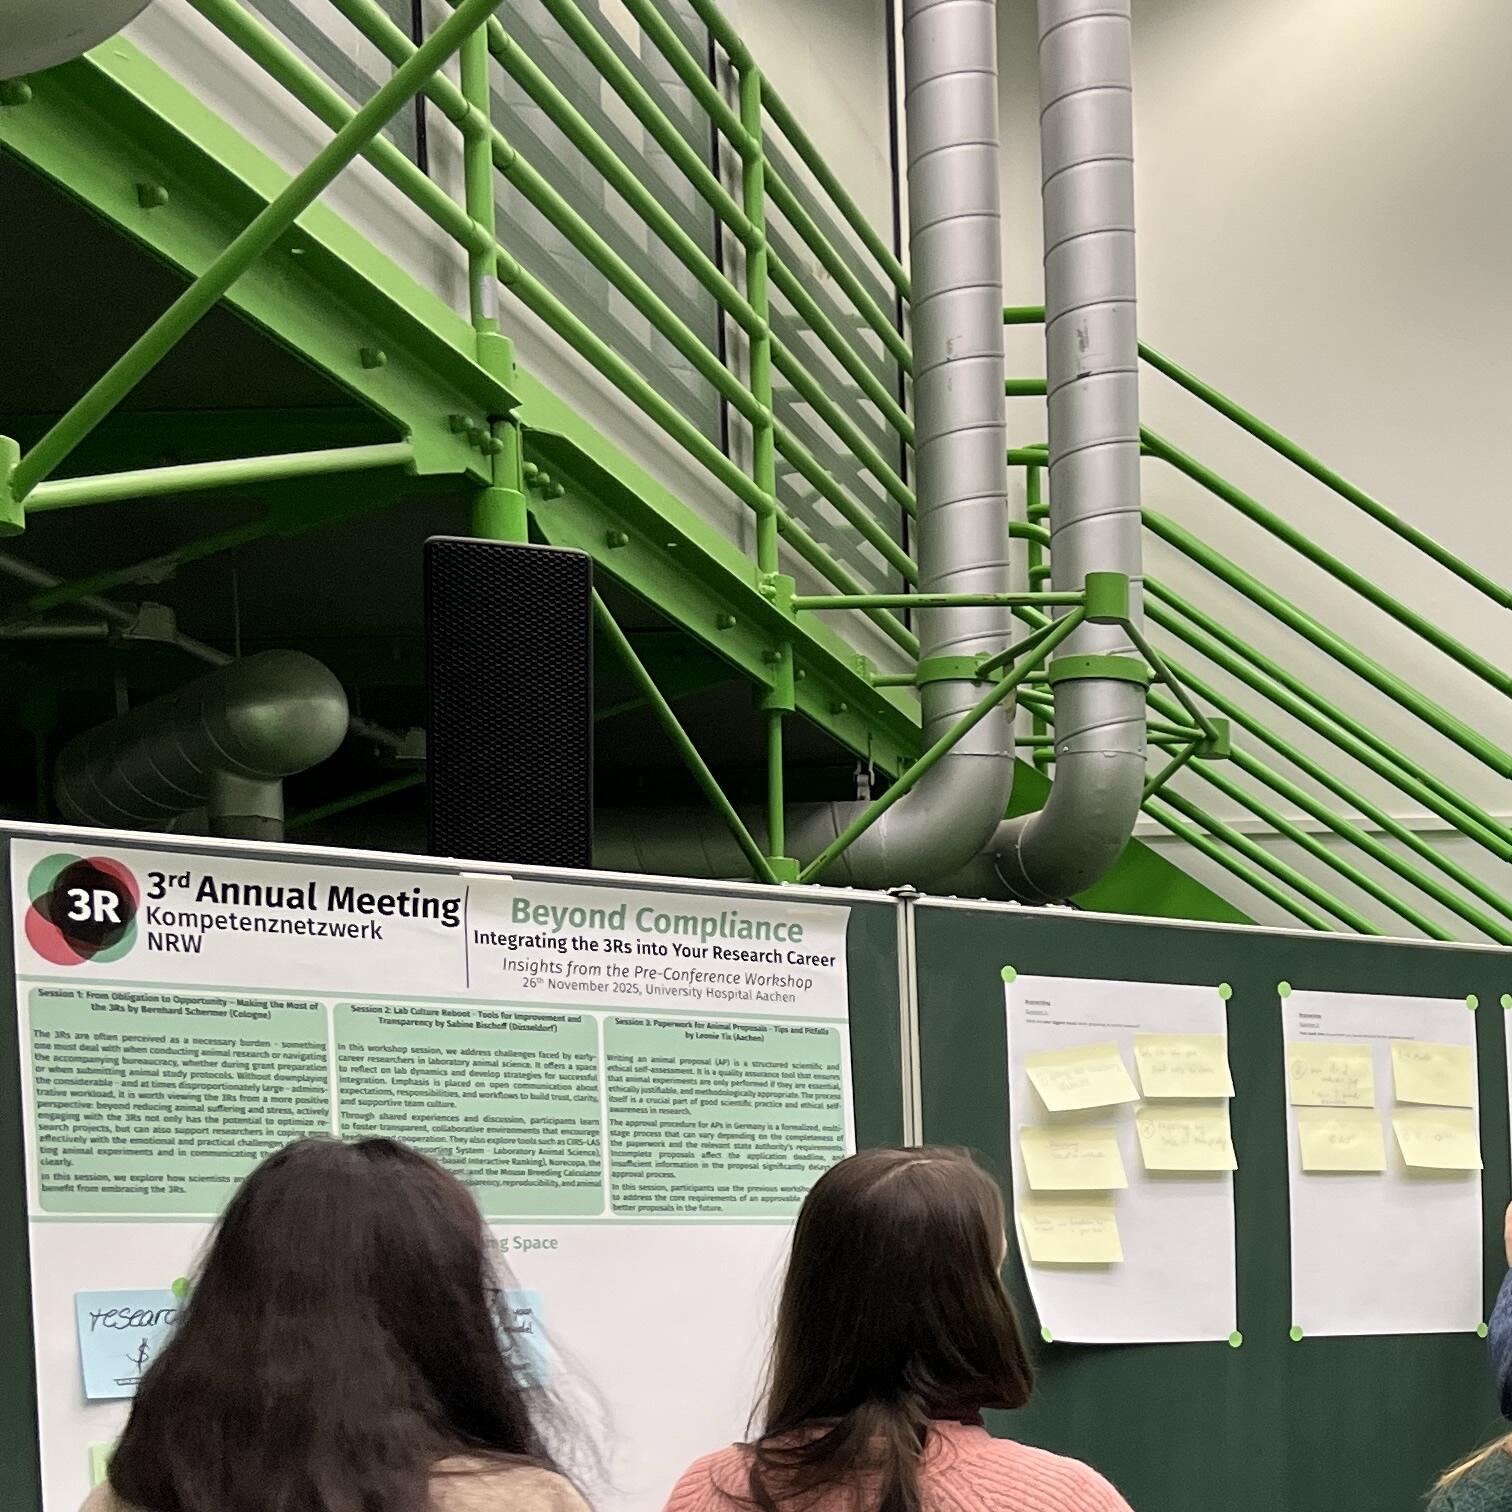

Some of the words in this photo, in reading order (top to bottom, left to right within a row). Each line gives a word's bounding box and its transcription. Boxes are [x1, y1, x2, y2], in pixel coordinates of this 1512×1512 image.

[66, 887, 122, 924] 3R
[147, 870, 190, 899] 3rd
[195, 875, 316, 910] Annual
[327, 885, 460, 927] Meeting
[146, 906, 382, 939] Kompetenznetzwerk
[511, 896, 627, 933] Beyond
[635, 904, 804, 943] Compliance
[147, 931, 201, 953] NRW
[474, 929, 567, 953] Integrating
[571, 935, 598, 951] the
[603, 938, 632, 953] 3Rs
[636, 938, 667, 956] into
[672, 942, 708, 958] Your
[712, 945, 782, 963] Research
[786, 950, 835, 966] Career
[503, 957, 562, 974] Insights
[565, 960, 601, 976] from
[606, 963, 629, 977] the
[634, 965, 740, 984] Pre-Conference
[745, 972, 812, 991] Workshop
[548, 978, 609, 992] November
[612, 981, 642, 995] 2025,
[645, 983, 702, 999] University
[705, 987, 752, 1001] Hospital
[755, 990, 795, 1002] Aachen
[513, 1236, 559, 1252] Space
[89, 1307, 182, 1332] researc
